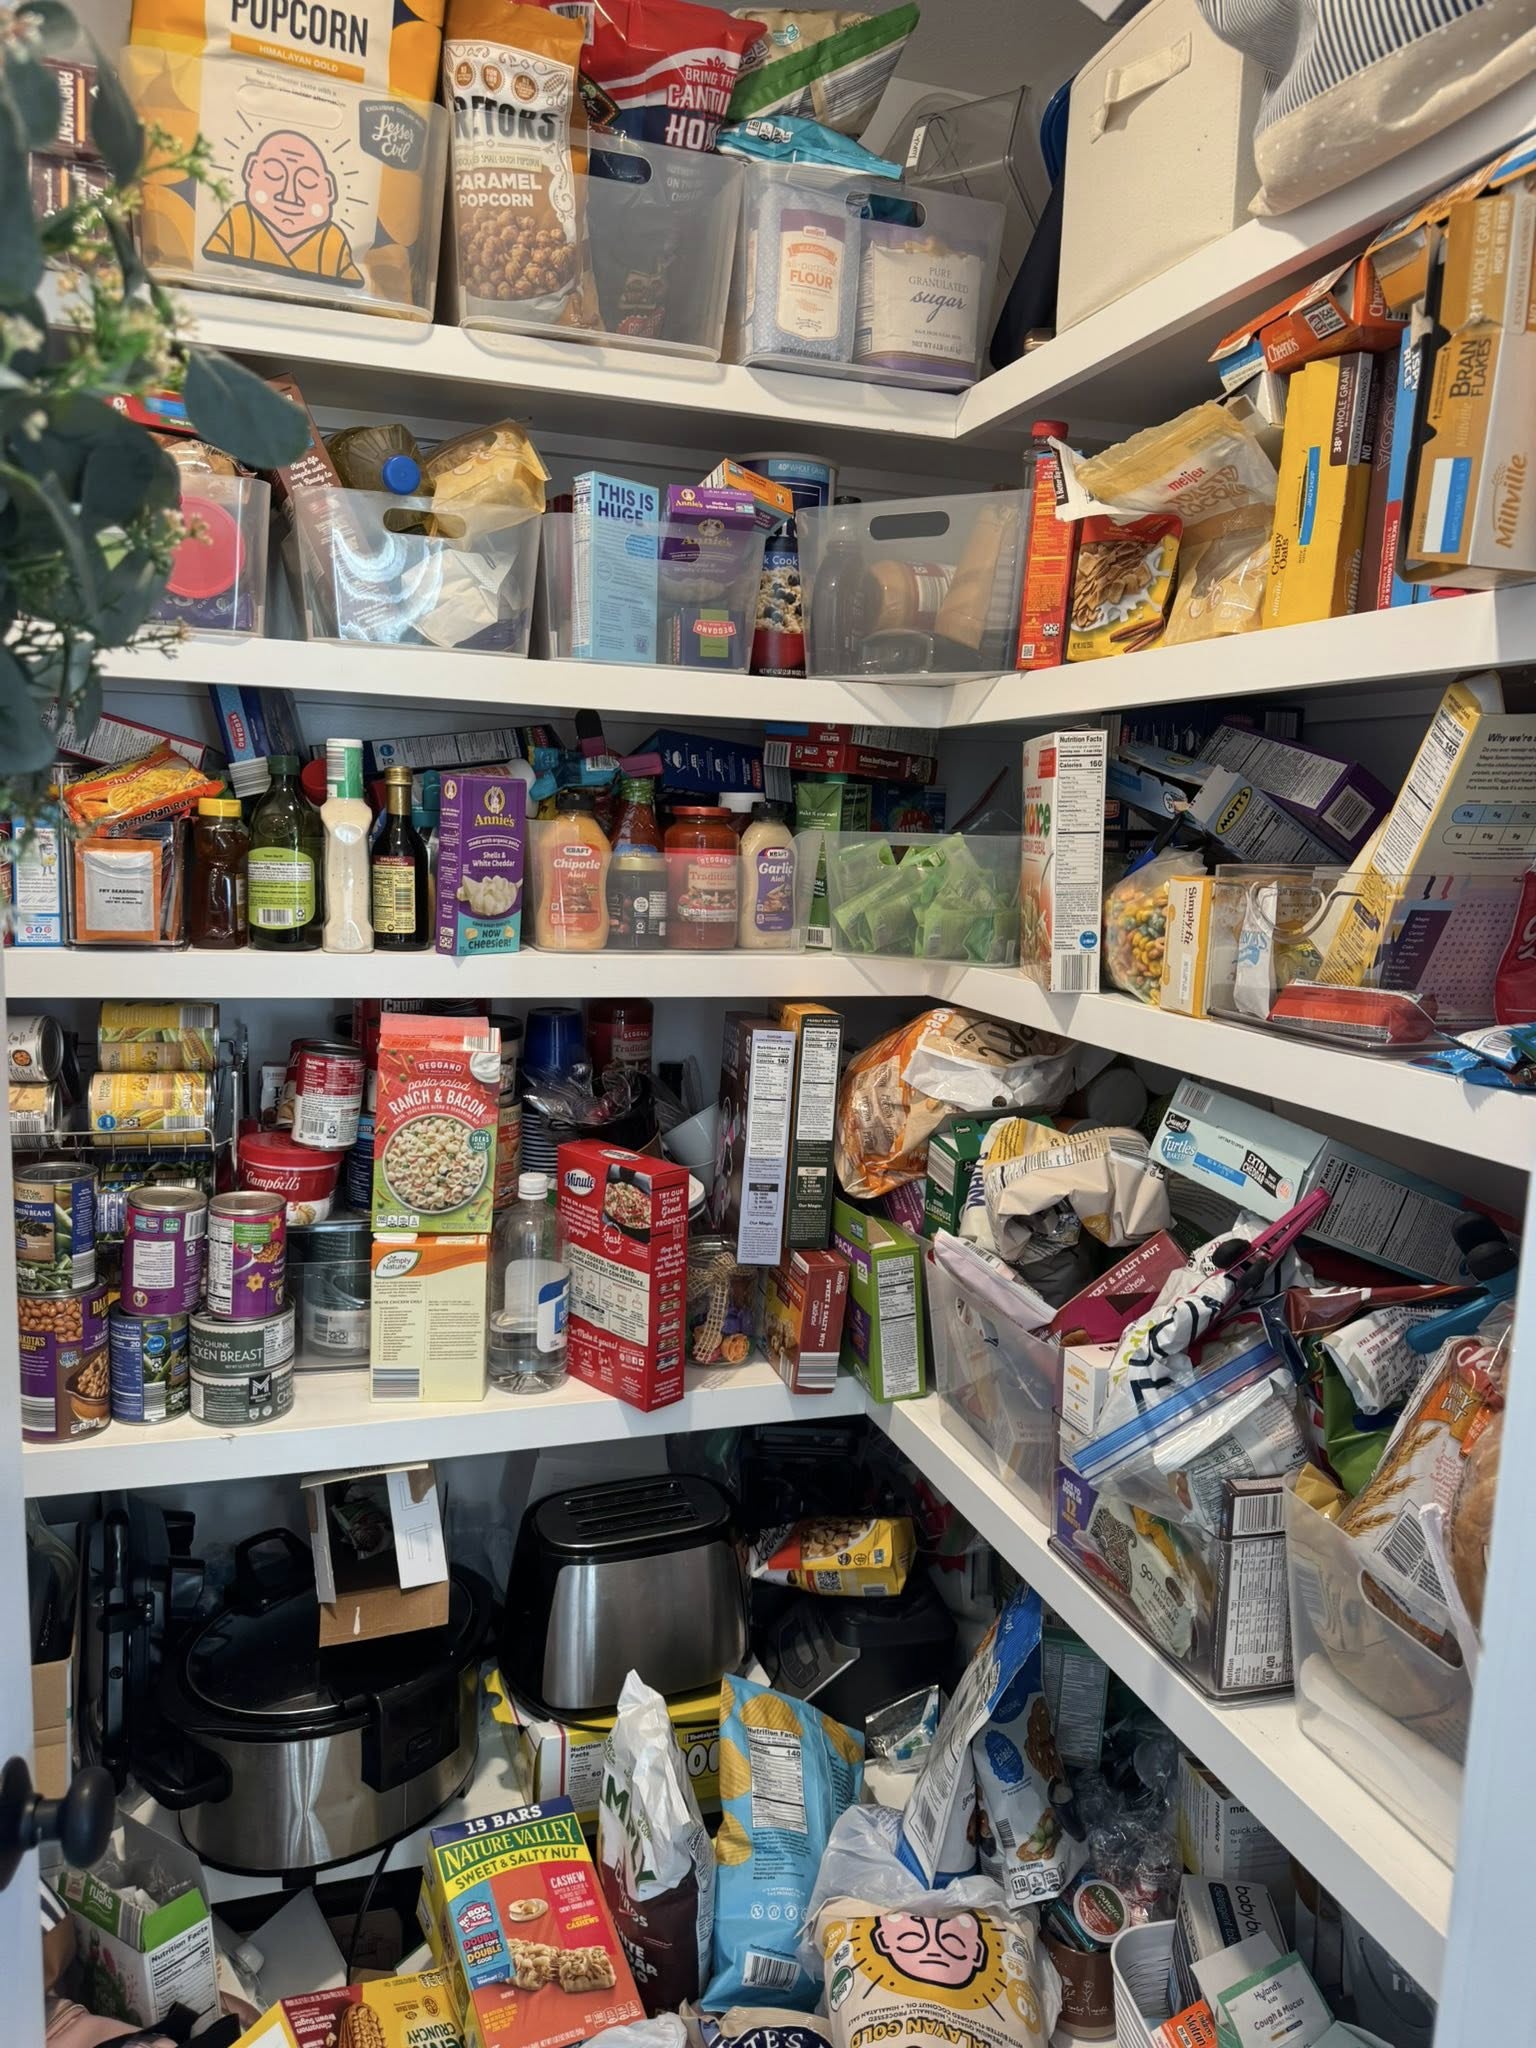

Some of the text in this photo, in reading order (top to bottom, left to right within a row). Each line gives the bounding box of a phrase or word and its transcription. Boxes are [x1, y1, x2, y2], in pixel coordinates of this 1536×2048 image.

[231, 0, 368, 57] POPCORN
[259, 45, 338, 73] HIMALAYAN GOLD
[685, 66, 717, 83] BRING
[371, 114, 415, 142] Lesser
[452, 95, 559, 142] RETORS
[381, 139, 410, 163] Evil
[459, 193, 533, 208] POPCORN
[1472, 201, 1493, 293] WHOLE GRAIN
[789, 270, 833, 290] FLOUR
[929, 266, 952, 278] PURE
[908, 276, 969, 294] GRANULATED
[911, 290, 967, 323] sugar
[1402, 347, 1411, 389] RICE
[1449, 339, 1477, 399] BRAN
[1470, 337, 1492, 398] FLAKES
[1335, 366, 1351, 434] WHOLE GRAIN
[1455, 401, 1473, 448] Millville
[1361, 443, 1372, 461] NO
[1168, 466, 1207, 492] meijer
[598, 481, 654, 513] THIS IS
[675, 499, 704, 510] Annie's
[1495, 452, 1528, 549] Millville
[597, 501, 644, 527] HUGE
[681, 536, 733, 548] Annie's
[1270, 532, 1284, 576] Crispy
[1279, 537, 1290, 569] Oats
[1271, 579, 1284, 617] Millville
[695, 624, 734, 635] REGGANO
[229, 712, 245, 750] REGGANO
[1487, 733, 1531, 743] Why we're
[1445, 741, 1458, 757] 140
[117, 804, 171, 831] Maruchan
[1219, 790, 1251, 831] MOTT'S
[474, 814, 516, 828] Annie's
[472, 859, 516, 868] White Cheddar
[483, 851, 507, 859] Shells &
[553, 858, 601, 870] Chipotle
[757, 861, 794, 877] Garlic
[1183, 886, 1198, 945] Simply fit
[482, 926, 502, 937] NOW
[623, 1030, 652, 1039] REGGANO
[418, 1061, 463, 1072] REGGANO
[406, 1077, 471, 1092] pasta salad
[388, 1088, 488, 1119] RANCH & BACON
[1162, 1135, 1197, 1156] Turtles
[1166, 1152, 1186, 1160] BAKED
[1246, 1153, 1268, 1175] EXTRA
[245, 1169, 302, 1192] Campbell's
[566, 1171, 595, 1189] Minute
[1242, 1162, 1265, 1185] CHEDDAR
[1319, 1157, 1336, 1185] Facts
[662, 1196, 680, 1205] OTHER
[670, 1188, 684, 1198] OUR
[1322, 1166, 1356, 1234] Calories 140
[29, 1209, 51, 1218] BEANS
[661, 1203, 682, 1219] Great
[925, 1199, 952, 1222] CLUBHOUSE
[655, 1214, 687, 1228] PRODUCTS
[603, 1231, 622, 1245] Fast
[834, 1235, 853, 1258] PACK
[382, 1262, 407, 1271] Nature
[387, 1255, 412, 1265] Simply
[605, 1261, 619, 1271] THEN
[1109, 1243, 1162, 1286] & SALTY NUT
[857, 1264, 868, 1277] 22
[879, 1271, 900, 1279] Nutrition
[810, 1300, 820, 1326] Cashew
[818, 1279, 832, 1348] SWEET SALTY NUT
[204, 1340, 231, 1349] CHUNK
[220, 1347, 264, 1363] BREAST
[1140, 1562, 1181, 1620] gomacro
[1225, 1657, 1235, 1687] Nutrition
[1233, 1667, 1241, 1686] Facts
[1265, 1655, 1276, 1683] 140 420
[748, 1727, 779, 1738] Nutrition
[570, 1742, 601, 1752] Nutrition
[570, 1750, 590, 1759] Facts
[465, 1804, 543, 1835] 15 BARS
[1229, 1826, 1251, 1837] quick
[442, 1817, 574, 1877] NATURE VALLEY
[455, 1846, 579, 1890] SWEET & SALTY NUT
[550, 1871, 586, 1889] CASHEW
[1012, 1876, 1026, 1889] 110
[88, 1883, 114, 1912] rusks
[1095, 1885, 1122, 1921] Panera
[467, 1904, 487, 1918] BOX
[471, 1911, 492, 1923] TOPS
[565, 1916, 600, 1931] CASHEWS
[151, 1925, 208, 1963] Nutrition Facts
[463, 1929, 500, 1949] DOUBLE
[484, 1939, 500, 1948] TOPS
[200, 1946, 210, 1959] 30
[466, 1944, 503, 1964] DOUBLE
[476, 1956, 493, 1964] GOOD
[154, 1968, 182, 1987] Calories
[1253, 1980, 1284, 2001] Hyland's
[860, 2005, 899, 2018] HIMALAYAN
[868, 2010, 907, 2023] PROCESSED
[918, 2002, 951, 2014] COCONUT
[1253, 1997, 1305, 2031] Cough & Mucus
[296, 2022, 333, 2034] Cinnamon
[299, 2013, 337, 2027] Brown Sugar
[1194, 2009, 1215, 2039] Children's
[406, 2021, 456, 2043] CRUNCHY
[851, 2017, 904, 2048] GOLD
[1183, 2013, 1207, 2047] Motrin
